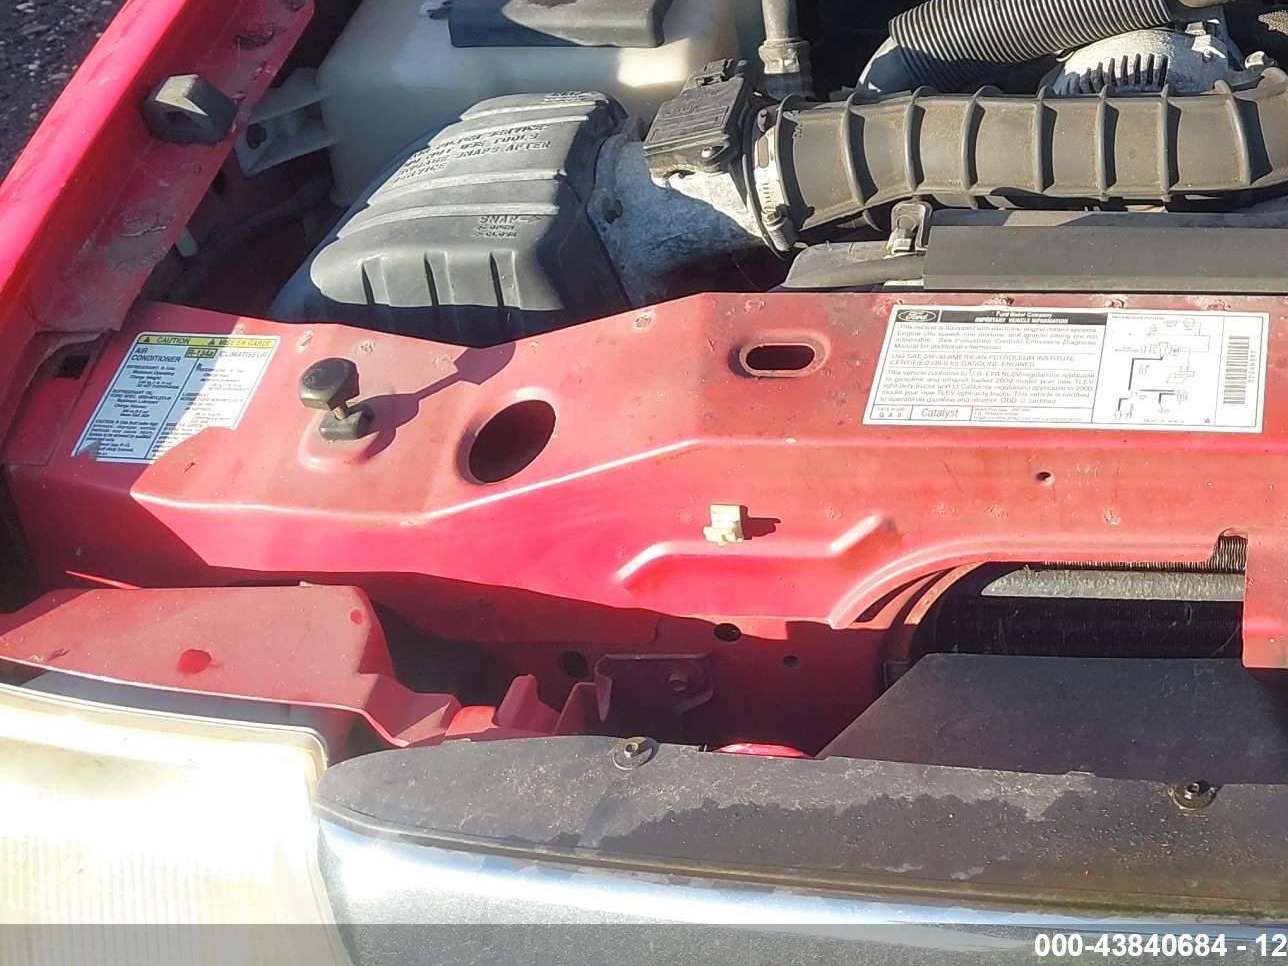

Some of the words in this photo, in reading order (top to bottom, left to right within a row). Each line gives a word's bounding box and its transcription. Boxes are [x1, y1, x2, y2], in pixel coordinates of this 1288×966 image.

[904, 311, 929, 319] Ford
[131, 354, 181, 363] CONDITIONER
[920, 408, 959, 419] Catalyst
